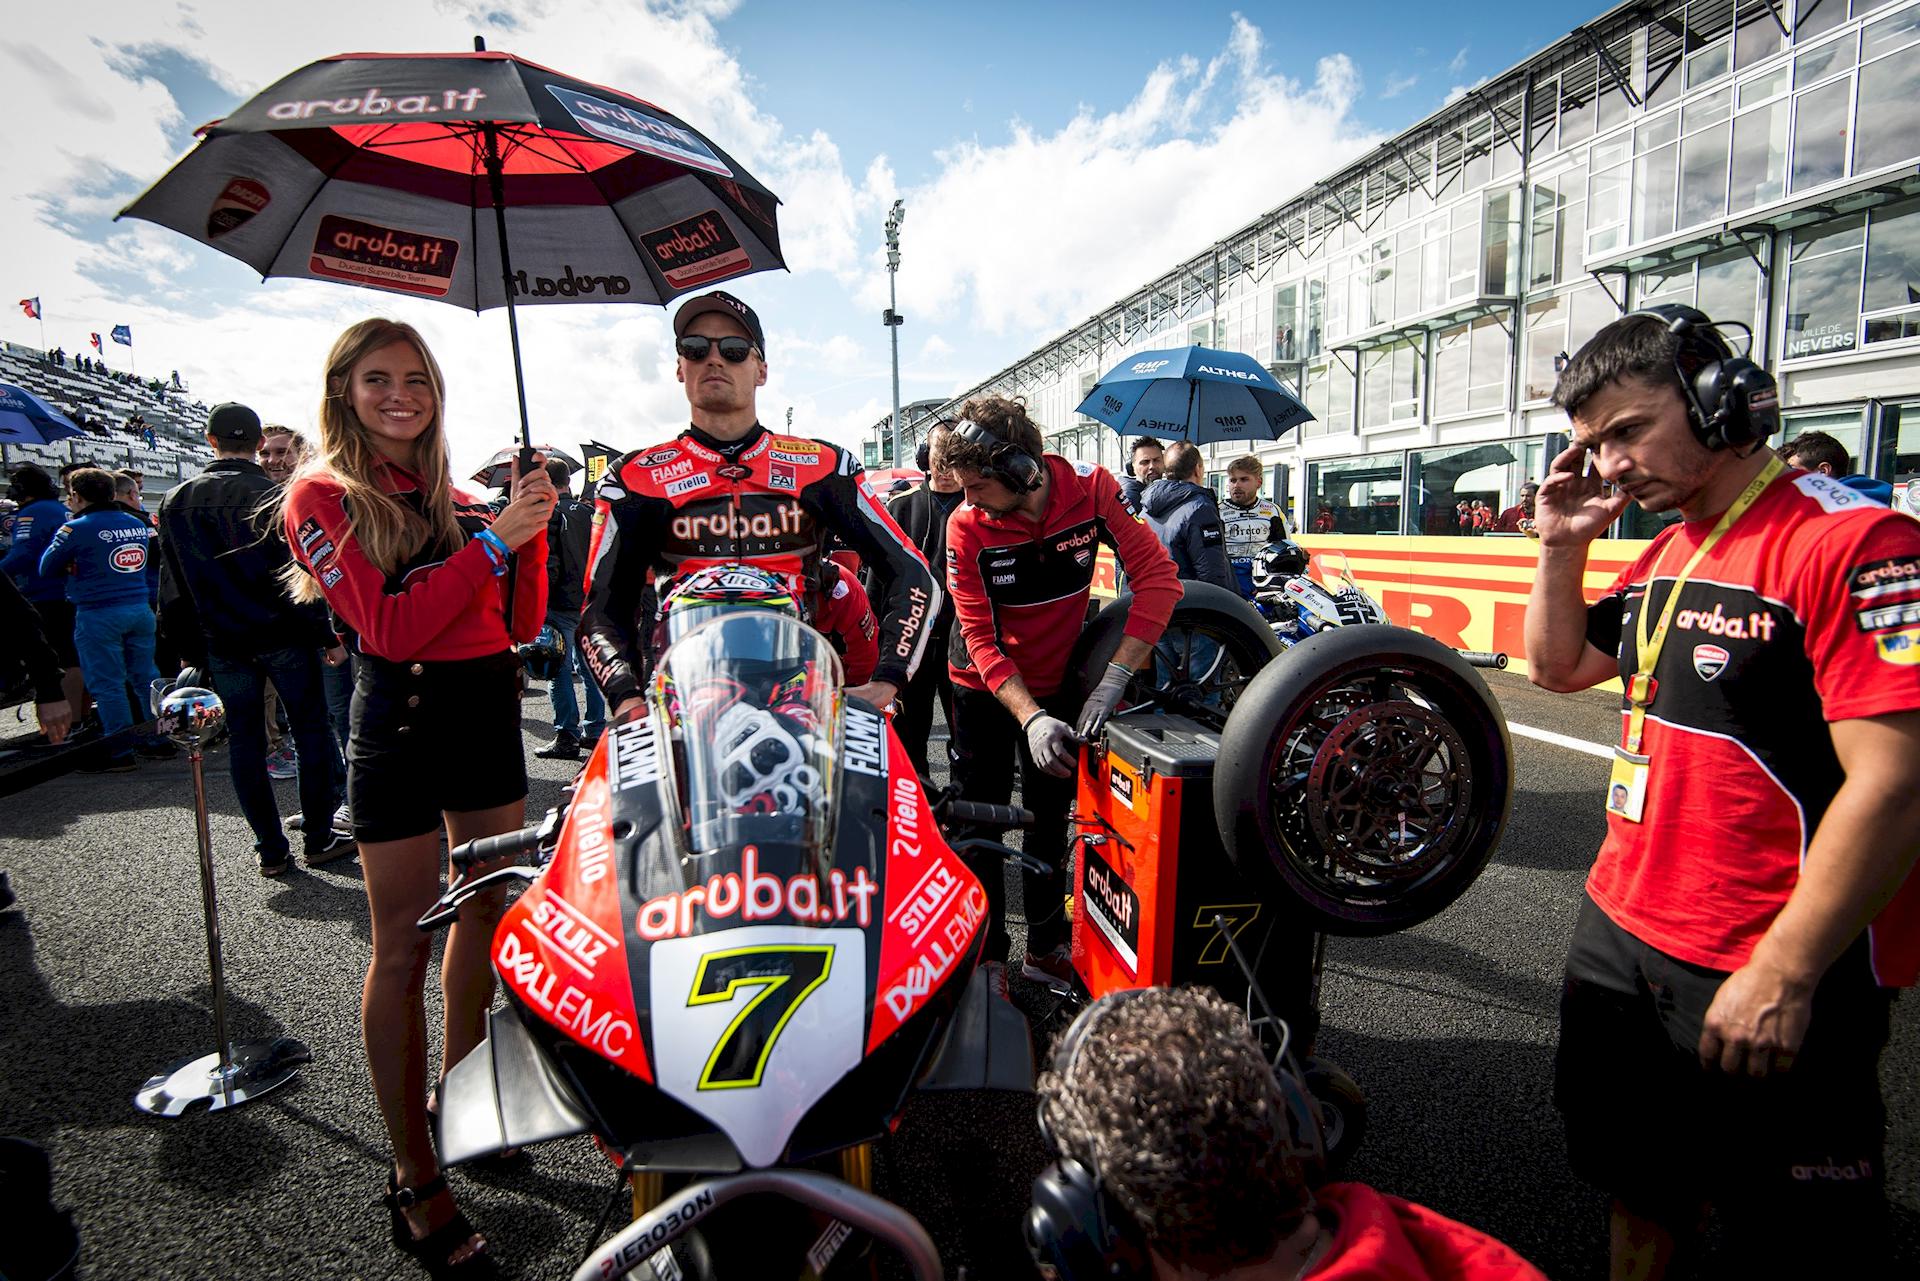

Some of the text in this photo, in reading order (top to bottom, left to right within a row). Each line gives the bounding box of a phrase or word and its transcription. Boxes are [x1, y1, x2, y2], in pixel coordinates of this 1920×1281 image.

[267, 88, 487, 120] aruba.it
[576, 101, 692, 146] aruba.it
[333, 230, 443, 265] aruba.it
[655, 218, 721, 260] aruba.it
[338, 260, 427, 283] Ducati Superbike Team
[1789, 332, 1854, 354] NEVERS
[1801, 323, 1841, 338] VILLE DE
[1131, 360, 1169, 371] BMP
[1197, 365, 1261, 382] ALTHEA
[686, 440, 722, 463] DUCATI
[651, 459, 693, 484] FIAMM
[679, 475, 707, 492] riello
[771, 475, 794, 486] FAI
[111, 527, 147, 539] YAMAHA
[672, 500, 804, 540] aruba.it
[700, 541, 781, 553] RACING
[1056, 525, 1098, 551] aruba.it
[119, 551, 141, 564] PATA
[992, 574, 1016, 584] FIAMM
[896, 587, 928, 657] aruba.it
[1676, 602, 1777, 642] aruba.it
[617, 714, 660, 791] FIAMM
[844, 707, 880, 776] FIAMM
[894, 777, 918, 839] riello
[578, 813, 609, 884] riello
[637, 845, 879, 941] aruba.it
[899, 867, 957, 935] STULZ
[1088, 864, 1132, 930] aruba.it
[532, 901, 608, 967] STULZ
[1192, 904, 1262, 965] 7
[686, 944, 836, 1092] 7
